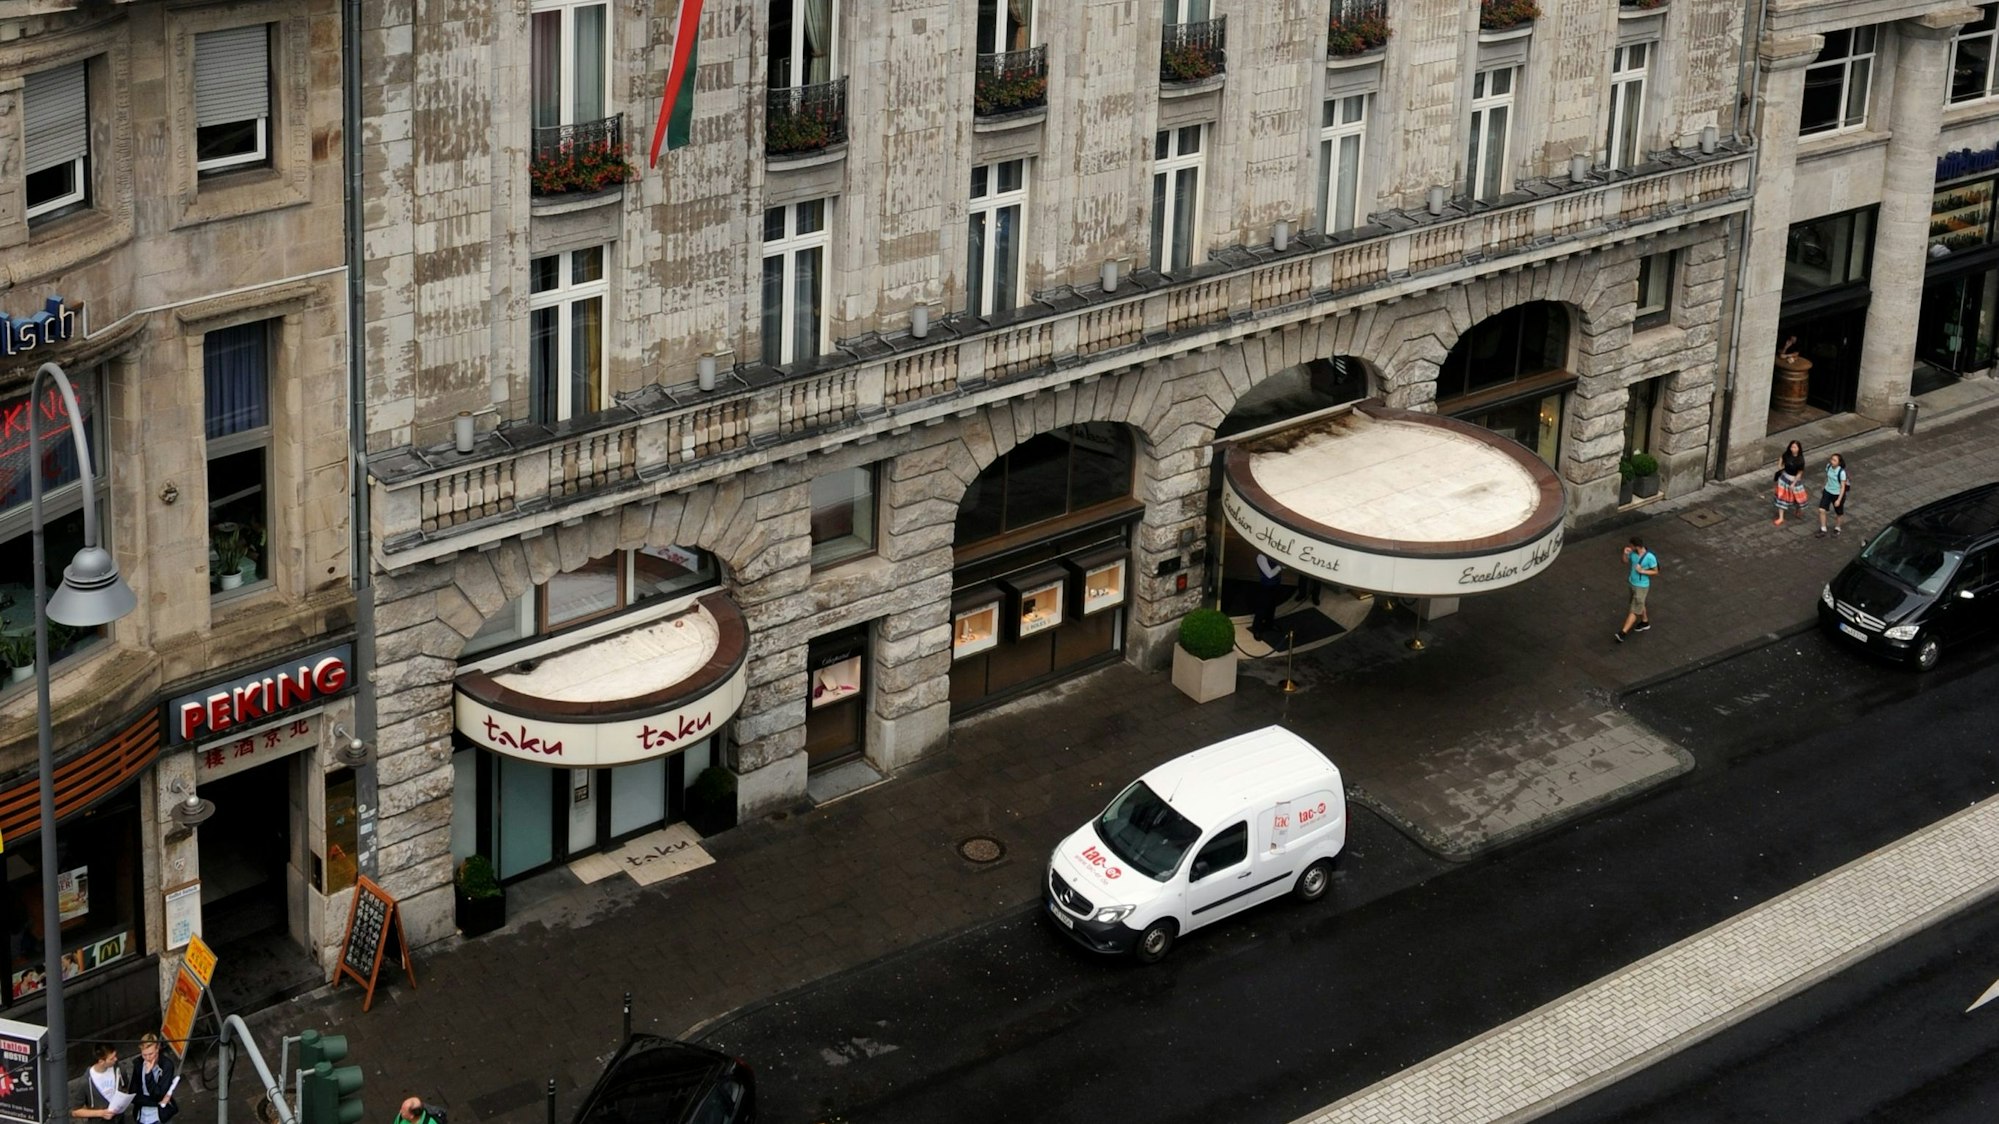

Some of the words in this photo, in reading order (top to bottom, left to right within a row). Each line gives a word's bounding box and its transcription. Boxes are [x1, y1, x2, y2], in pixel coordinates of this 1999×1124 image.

[1223, 493, 1252, 534] Excelsior
[1255, 526, 1296, 556] Hotel
[1298, 546, 1340, 571] Ernst
[1458, 561, 1518, 585] Excelsior
[181, 656, 347, 741] PEKING
[483, 714, 563, 756] taku
[636, 711, 712, 750] taku
[626, 841, 690, 866] taku
